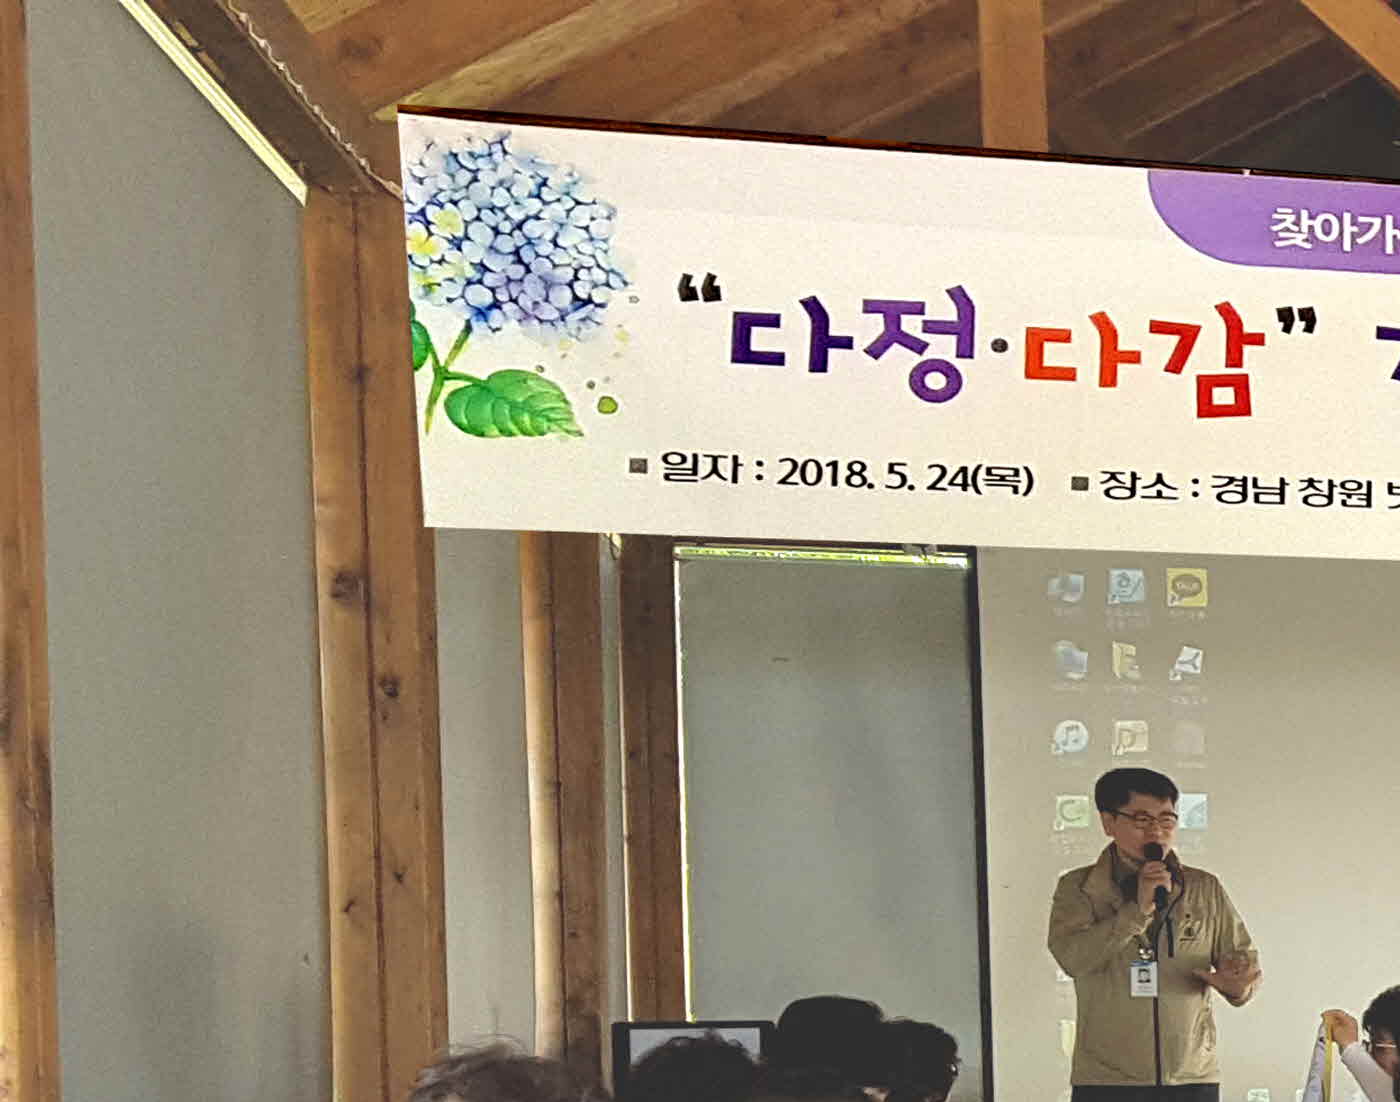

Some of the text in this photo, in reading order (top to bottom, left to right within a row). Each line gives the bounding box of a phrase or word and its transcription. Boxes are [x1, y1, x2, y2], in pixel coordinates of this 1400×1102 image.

[662, 452, 743, 484] 일자
[777, 458, 874, 489] 2018.
[926, 464, 1034, 496] 24(목)
[1100, 471, 1179, 500] 장소
[1211, 475, 1290, 505] 경남
[1298, 477, 1372, 508] 창원
